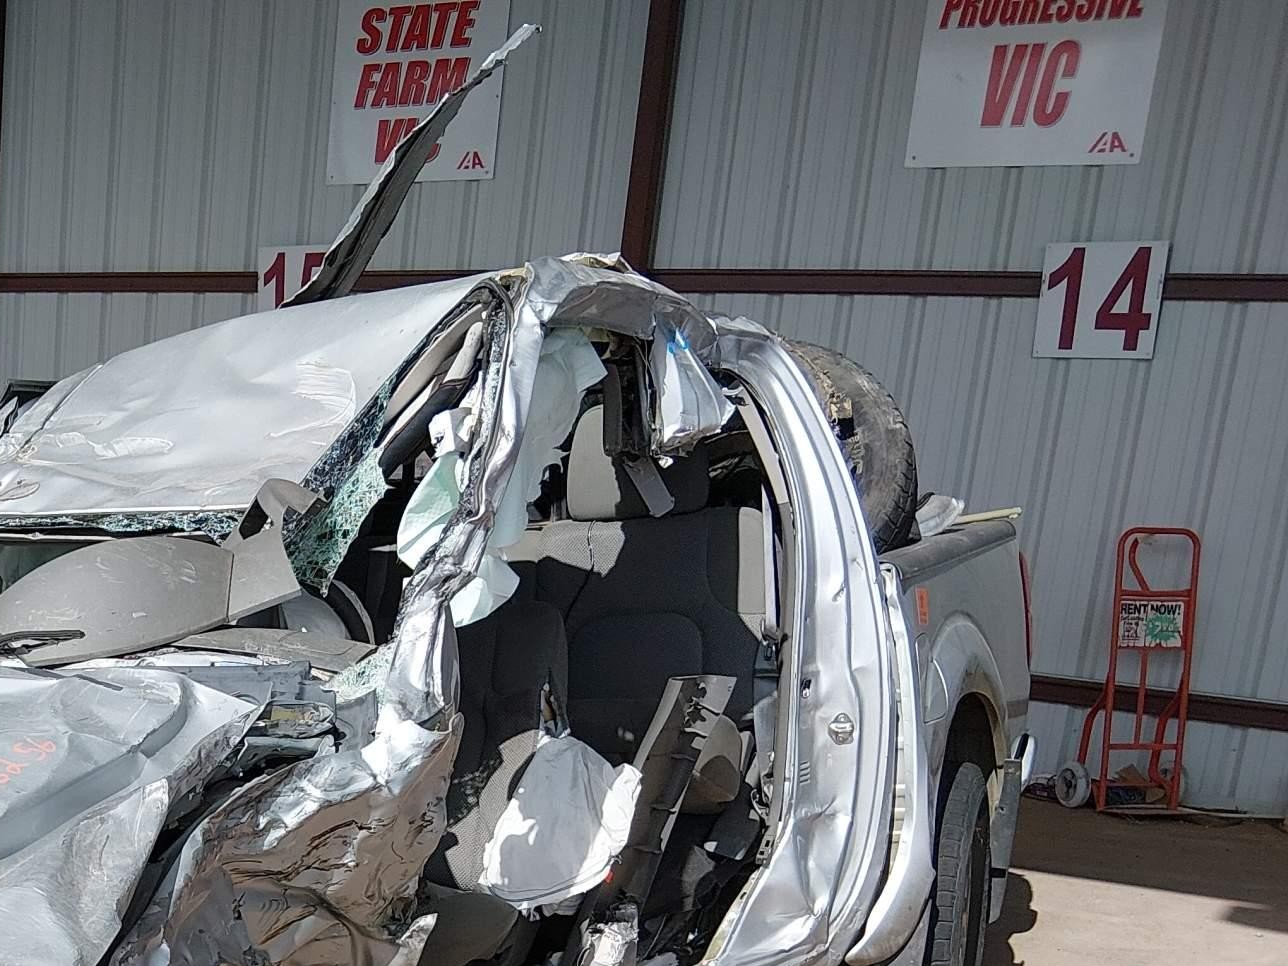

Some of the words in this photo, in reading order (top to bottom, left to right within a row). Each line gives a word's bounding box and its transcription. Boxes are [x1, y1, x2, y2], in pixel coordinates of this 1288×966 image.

[356, 0, 480, 56] STATE
[354, 57, 471, 110] FARM
[980, 39, 1082, 128] VIC
[1047, 246, 1153, 351] 14
[1120, 603, 1148, 615] RENT
[1150, 603, 1182, 616] NOW!
